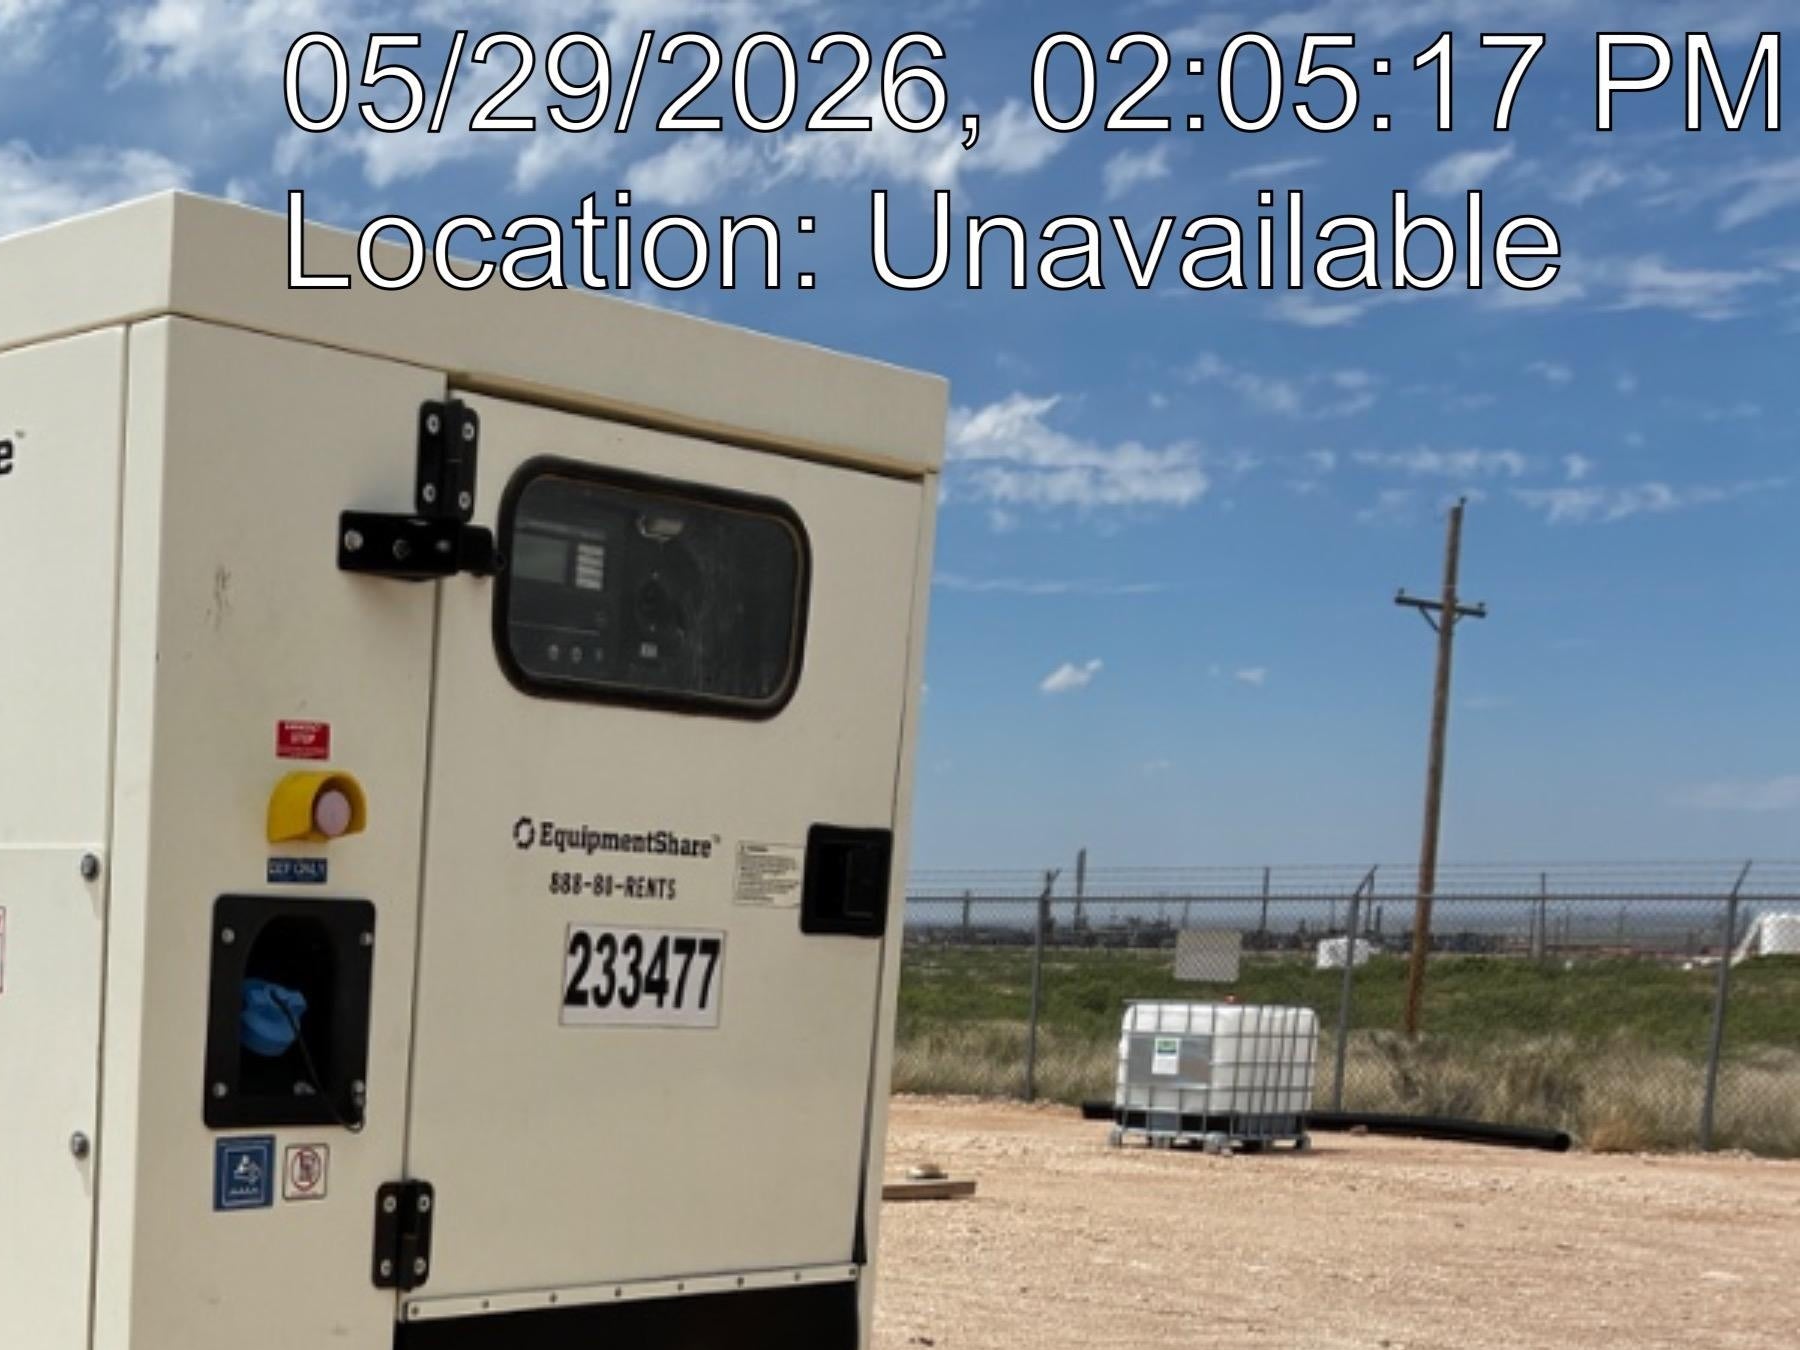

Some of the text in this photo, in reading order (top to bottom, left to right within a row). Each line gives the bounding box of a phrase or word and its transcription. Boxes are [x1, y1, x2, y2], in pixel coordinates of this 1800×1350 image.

[539, 821, 713, 858] EquipmentShare
[549, 871, 677, 900] 888-80-RENTS
[563, 930, 721, 1009] 233477
